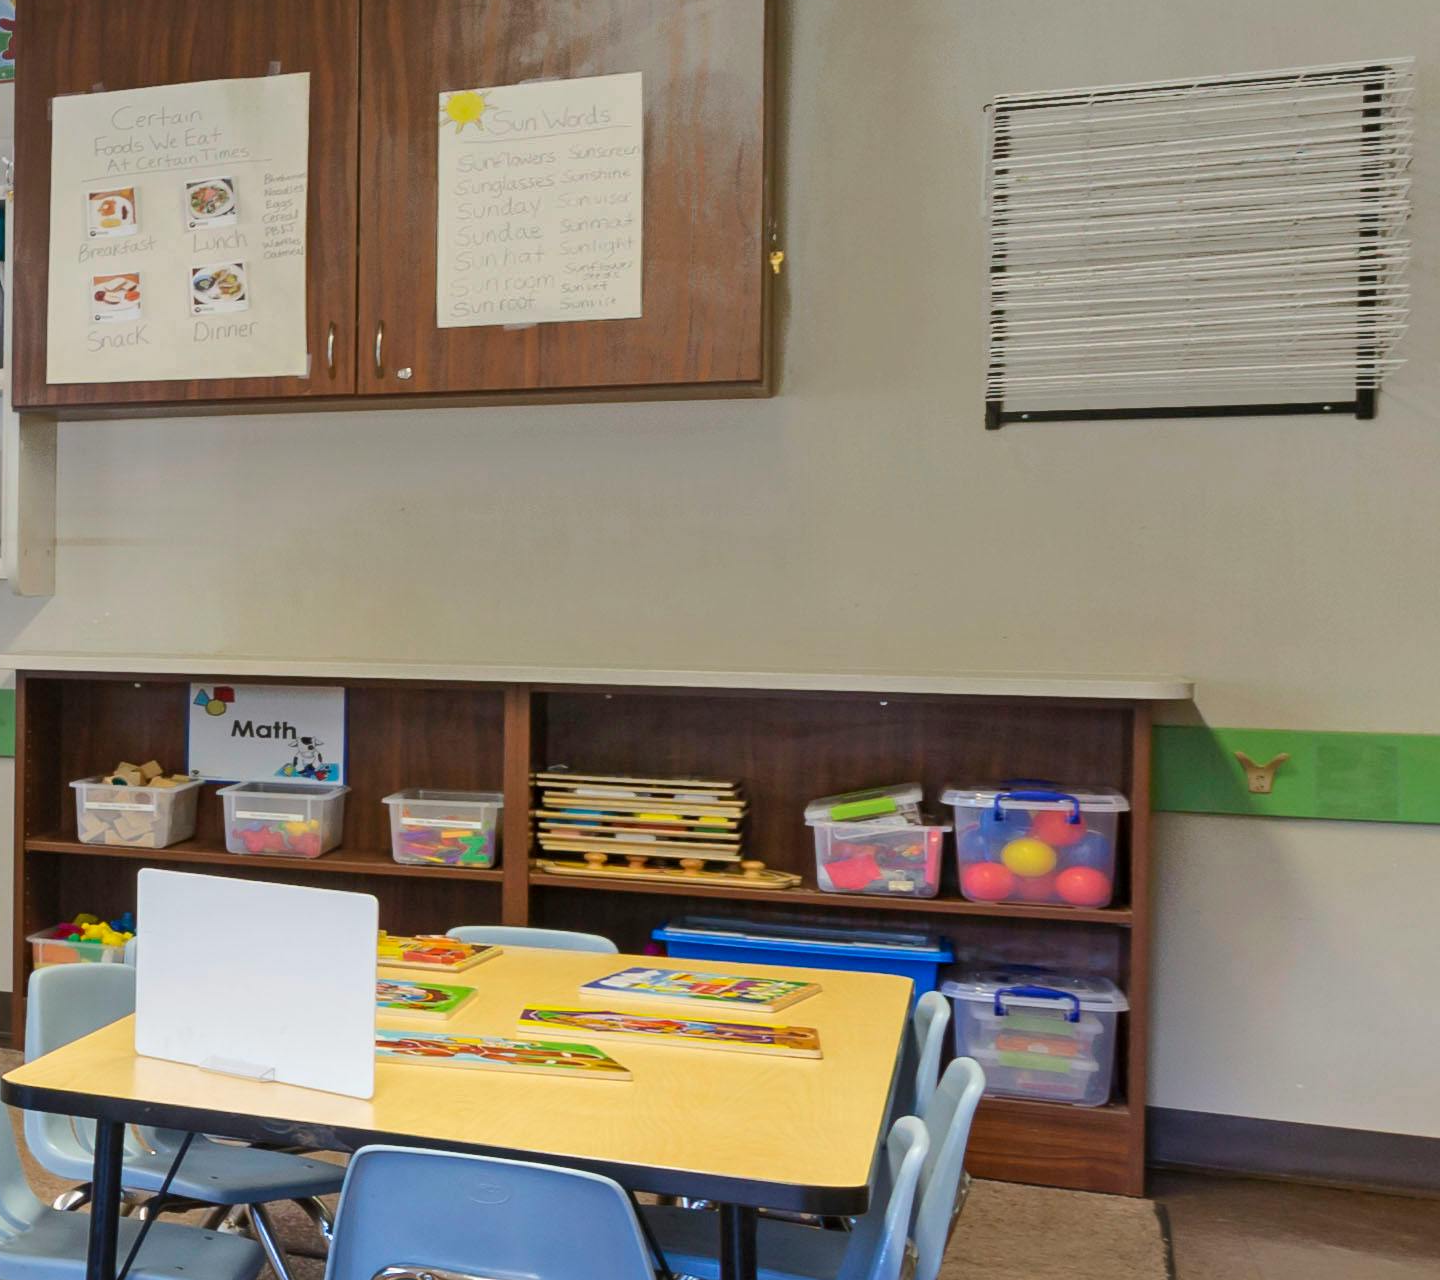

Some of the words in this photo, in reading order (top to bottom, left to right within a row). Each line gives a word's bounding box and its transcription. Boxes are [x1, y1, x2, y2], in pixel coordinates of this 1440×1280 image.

[111, 105, 203, 130] Certain
[487, 109, 537, 135] Sun
[541, 104, 611, 129] Words
[94, 136, 144, 157] Foods
[150, 135, 178, 152] We
[184, 129, 222, 147] Eat
[106, 157, 130, 174] At
[136, 154, 199, 170] Certain
[199, 146, 250, 162] Times
[456, 151, 557, 173] Sunflowers
[454, 173, 555, 200] Sunglasses
[560, 167, 632, 184] Sunshine
[266, 199, 293, 213] Eggs
[457, 196, 542, 221] Sunday
[78, 235, 158, 264] Breakfast
[193, 230, 248, 253] Lunch
[455, 222, 543, 247] Sundae
[87, 323, 152, 353] Snack
[193, 320, 259, 343] Dinner
[231, 720, 297, 741] Math
